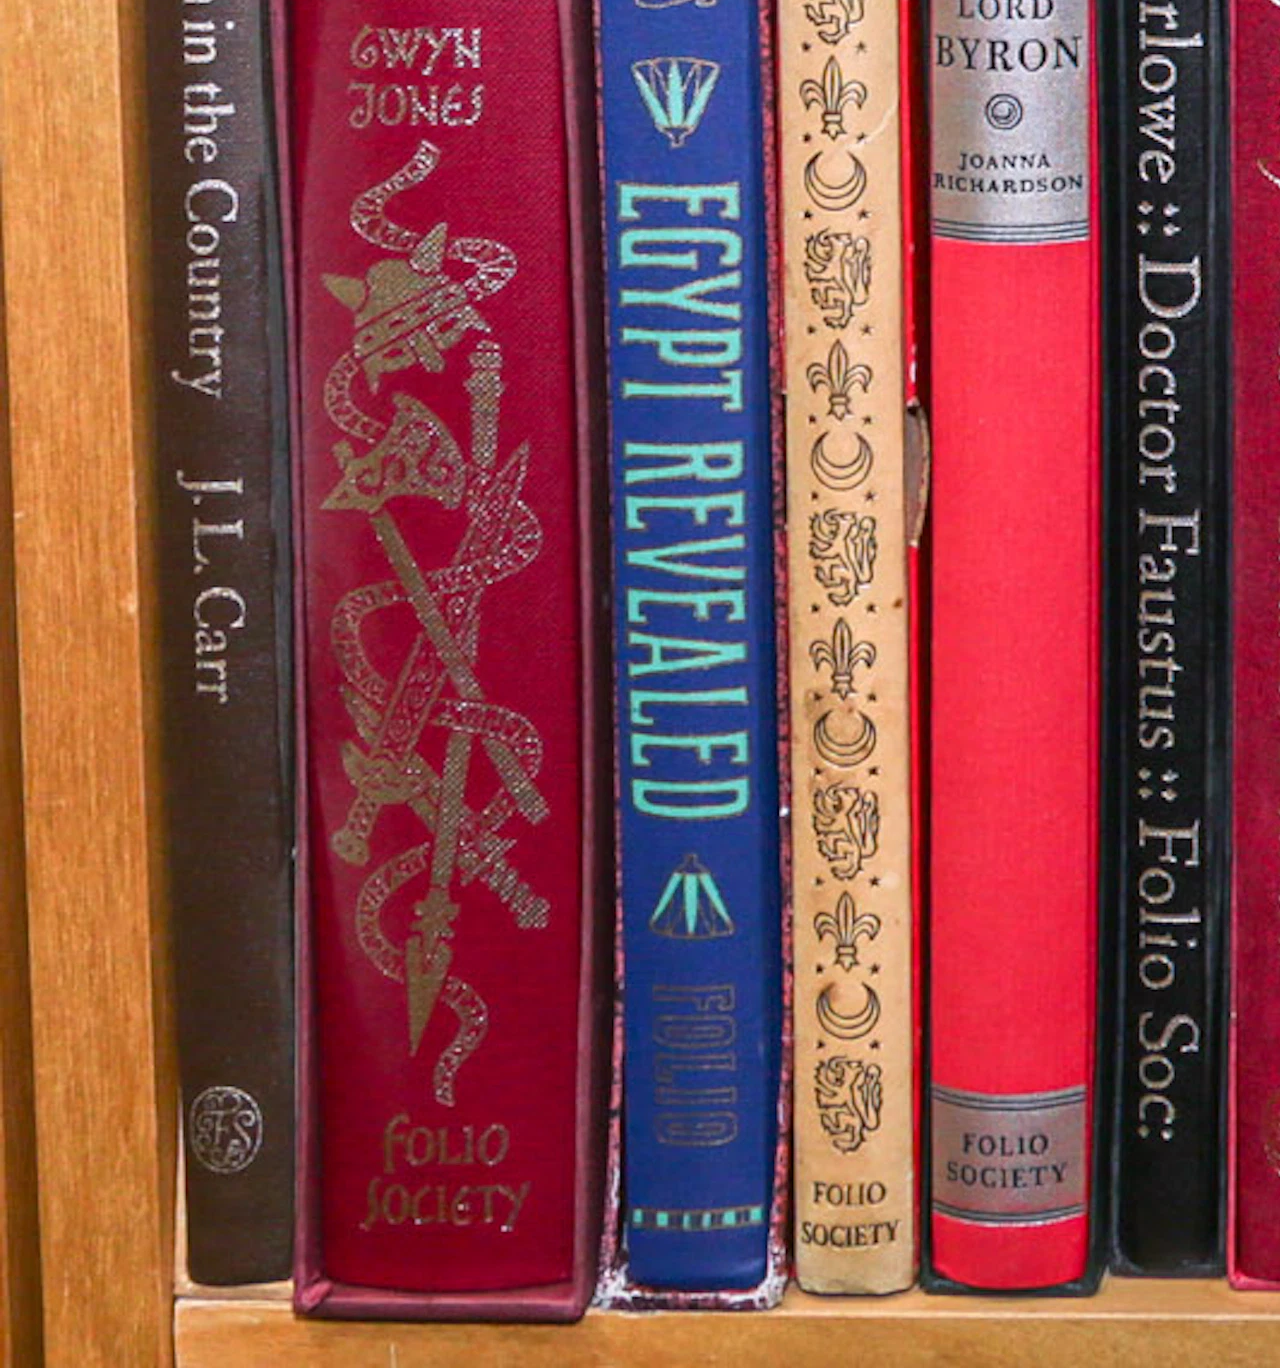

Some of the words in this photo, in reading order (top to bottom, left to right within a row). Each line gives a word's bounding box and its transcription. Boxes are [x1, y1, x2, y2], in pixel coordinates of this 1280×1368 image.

[182, 19, 234, 65] in
[936, 35, 1081, 72] BYRON
[183, 81, 235, 164] the
[348, 84, 484, 128] JONES
[934, 173, 1083, 193] RICHARDSON
[959, 153, 1051, 171] JOANNA
[172, 179, 240, 399] Country
[615, 181, 743, 411] EGYPT
[1139, 254, 1201, 494] Doctor
[194, 585, 247, 704] Carr
[623, 441, 749, 819] REVEALED
[1139, 509, 1199, 752] Faustus
[1139, 819, 1200, 991] Folio
[652, 985, 738, 1146] FOLIO
[947, 1162, 1067, 1188] SOCIETY
[963, 1133, 1048, 1156] FOLIO
[812, 1181, 887, 1208] FOLIO
[802, 1220, 901, 1249] SOCIETY
